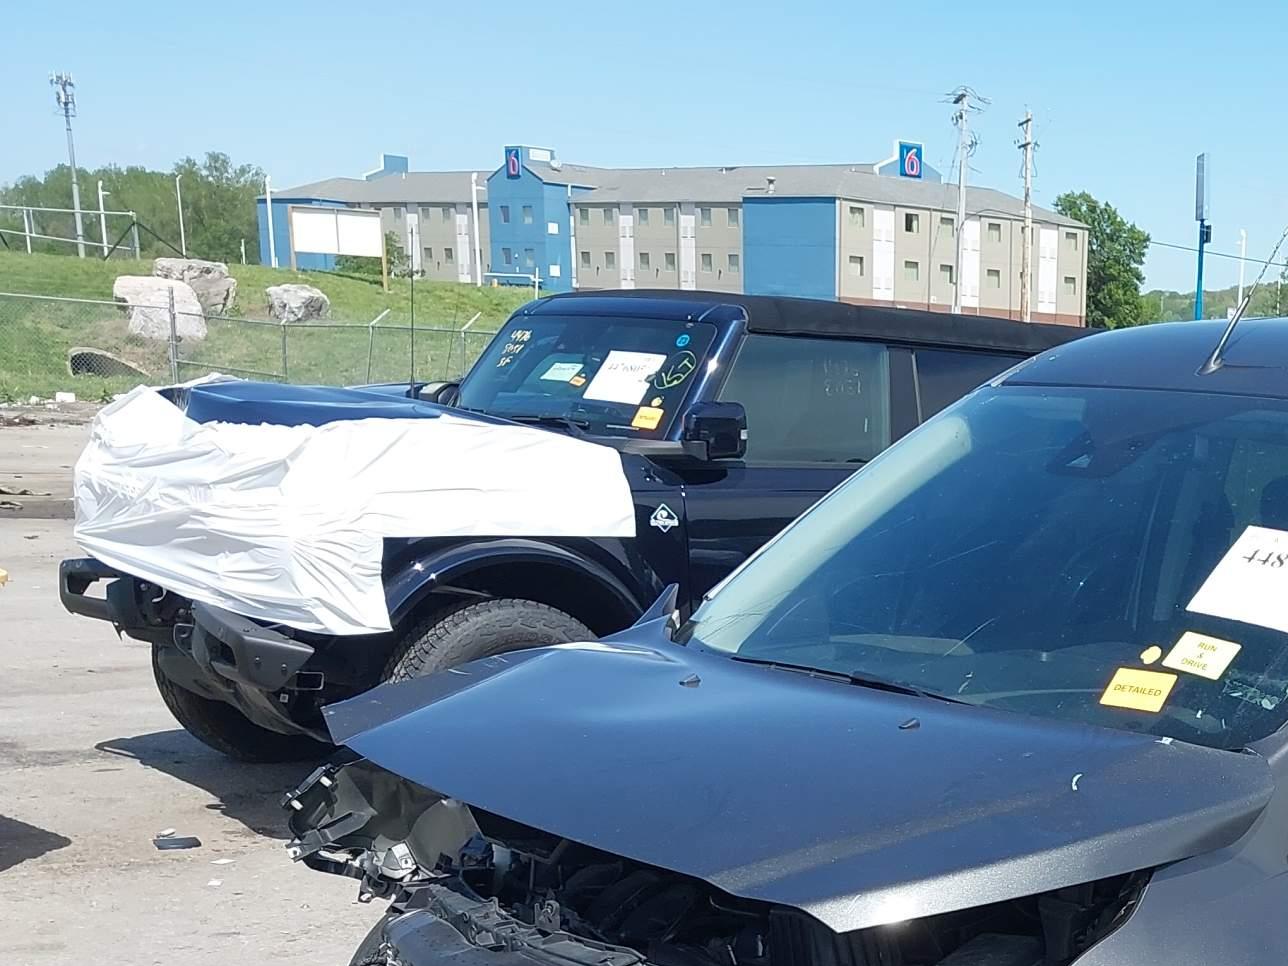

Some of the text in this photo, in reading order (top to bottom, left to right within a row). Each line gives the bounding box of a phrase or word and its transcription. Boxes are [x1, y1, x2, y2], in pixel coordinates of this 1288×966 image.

[904, 148, 920, 176] 6
[1198, 641, 1217, 653] RUN
[1181, 657, 1209, 671] DRIVE
[1113, 683, 1162, 697] DETAILED
